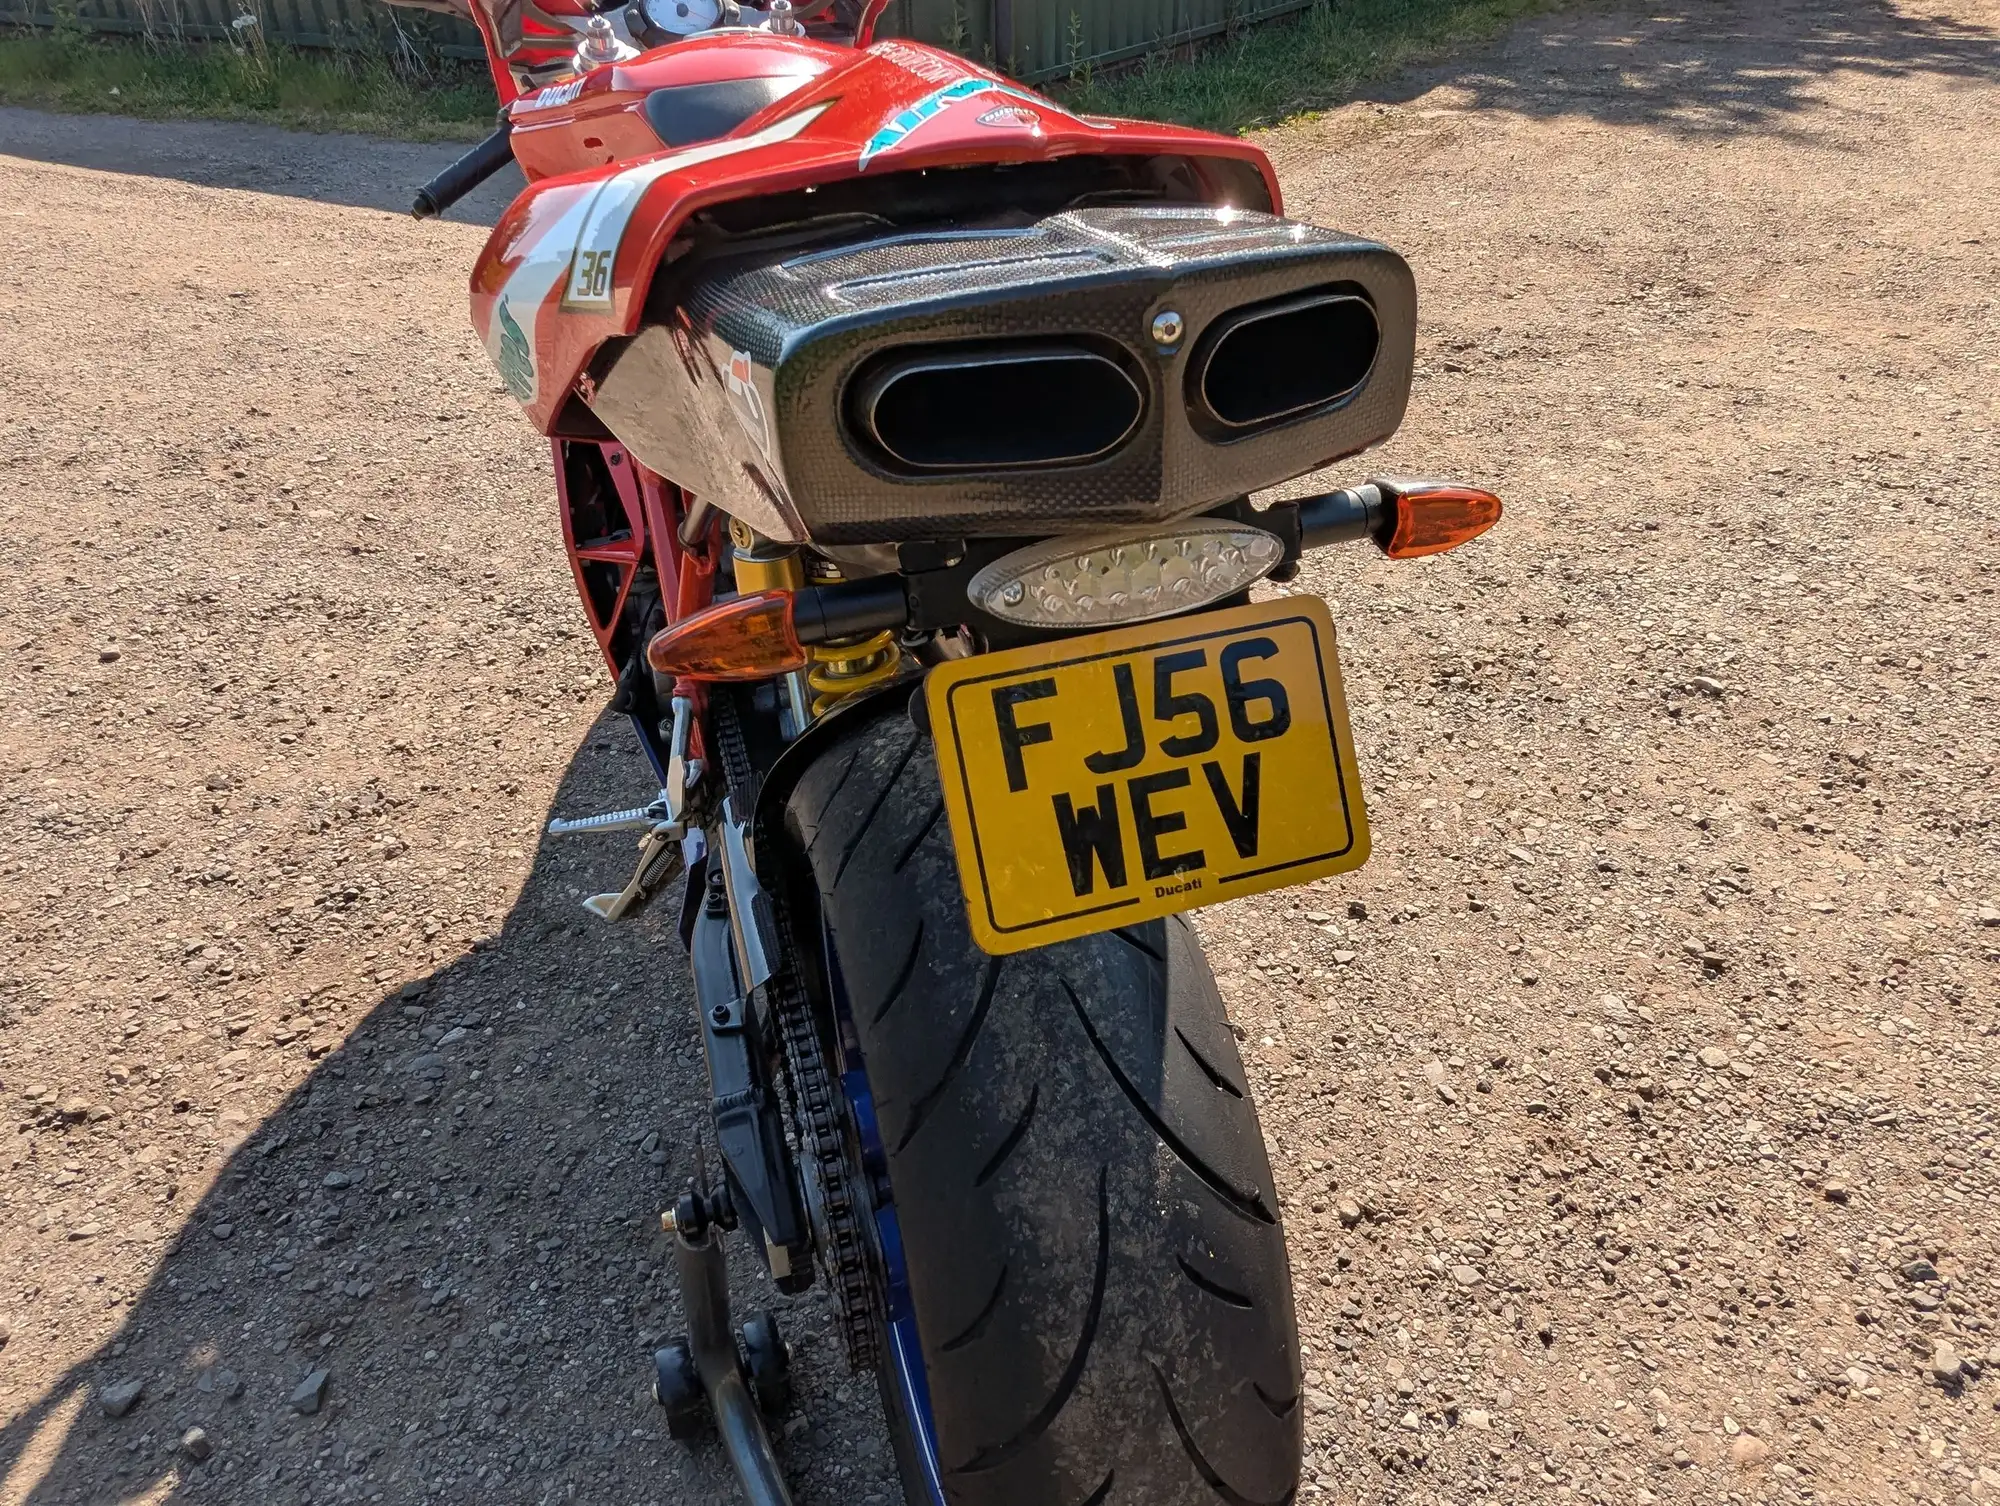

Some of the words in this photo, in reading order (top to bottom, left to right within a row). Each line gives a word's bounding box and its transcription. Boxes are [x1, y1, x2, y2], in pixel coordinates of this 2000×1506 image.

[577, 250, 611, 296] 36
[991, 637, 1291, 793] FJ56
[1051, 752, 1261, 897] WEV
[1155, 878, 1202, 898] Ducati
